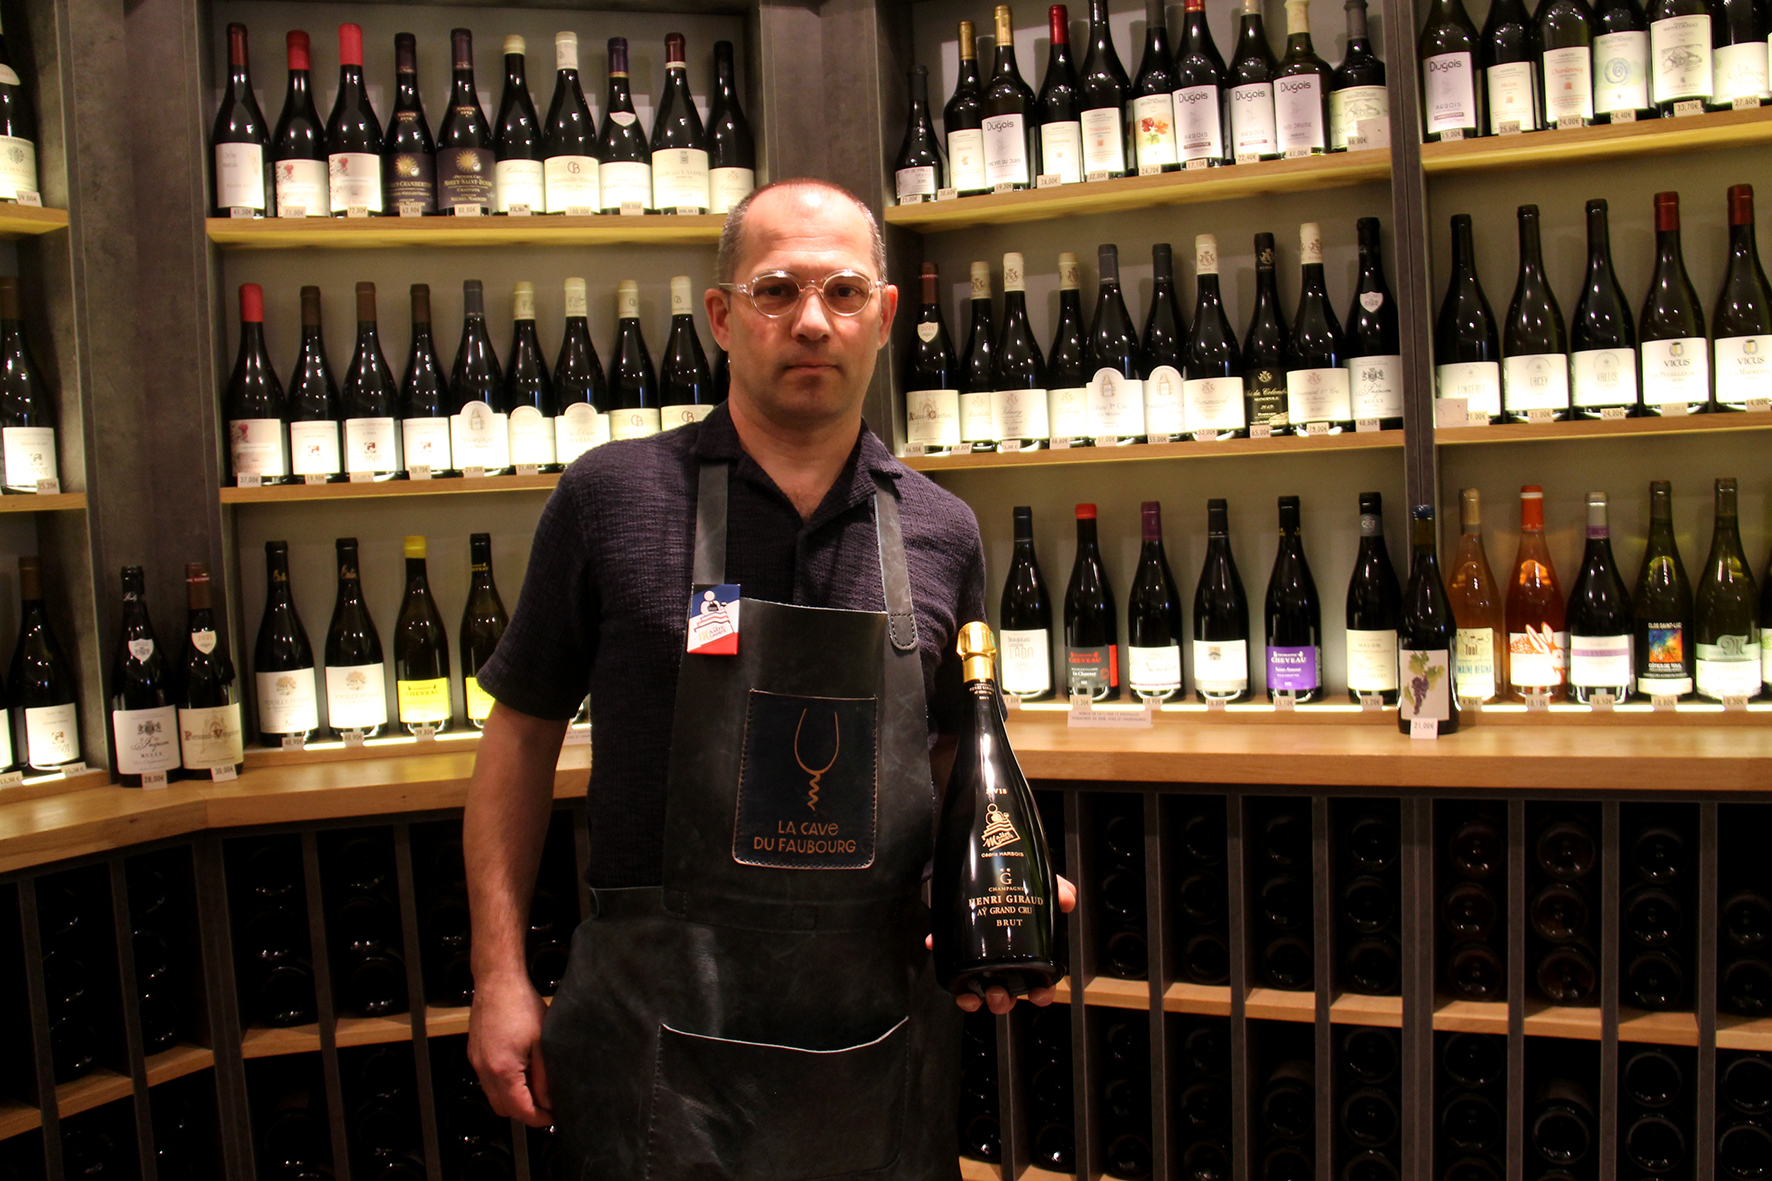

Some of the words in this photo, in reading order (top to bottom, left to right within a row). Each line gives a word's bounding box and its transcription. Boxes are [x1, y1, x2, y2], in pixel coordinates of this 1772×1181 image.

[1429, 59, 1462, 74] Dugois
[1280, 80, 1311, 94] Dugois
[1178, 91, 1209, 105] Dugois
[1235, 89, 1266, 102] Dugois
[1435, 102, 1462, 111] ARBOIS
[986, 119, 1015, 133] Dugois
[1663, 358, 1691, 367] VICUS
[1737, 356, 1765, 366] VICUS
[1270, 656, 1307, 664] CHEVEAU
[406, 689, 440, 697] CHEVEAU
[1414, 721, 1434, 731] 21,00€
[778, 820, 797, 835] LA
[753, 836, 775, 851] DU
[777, 837, 857, 854] FAUBOURG
[968, 895, 1003, 908] HENRI
[1005, 894, 1044, 906] GIRAUD
[990, 906, 1017, 916] GRAND
[1017, 906, 1034, 915] CRU
[996, 919, 1024, 927] BRUT
